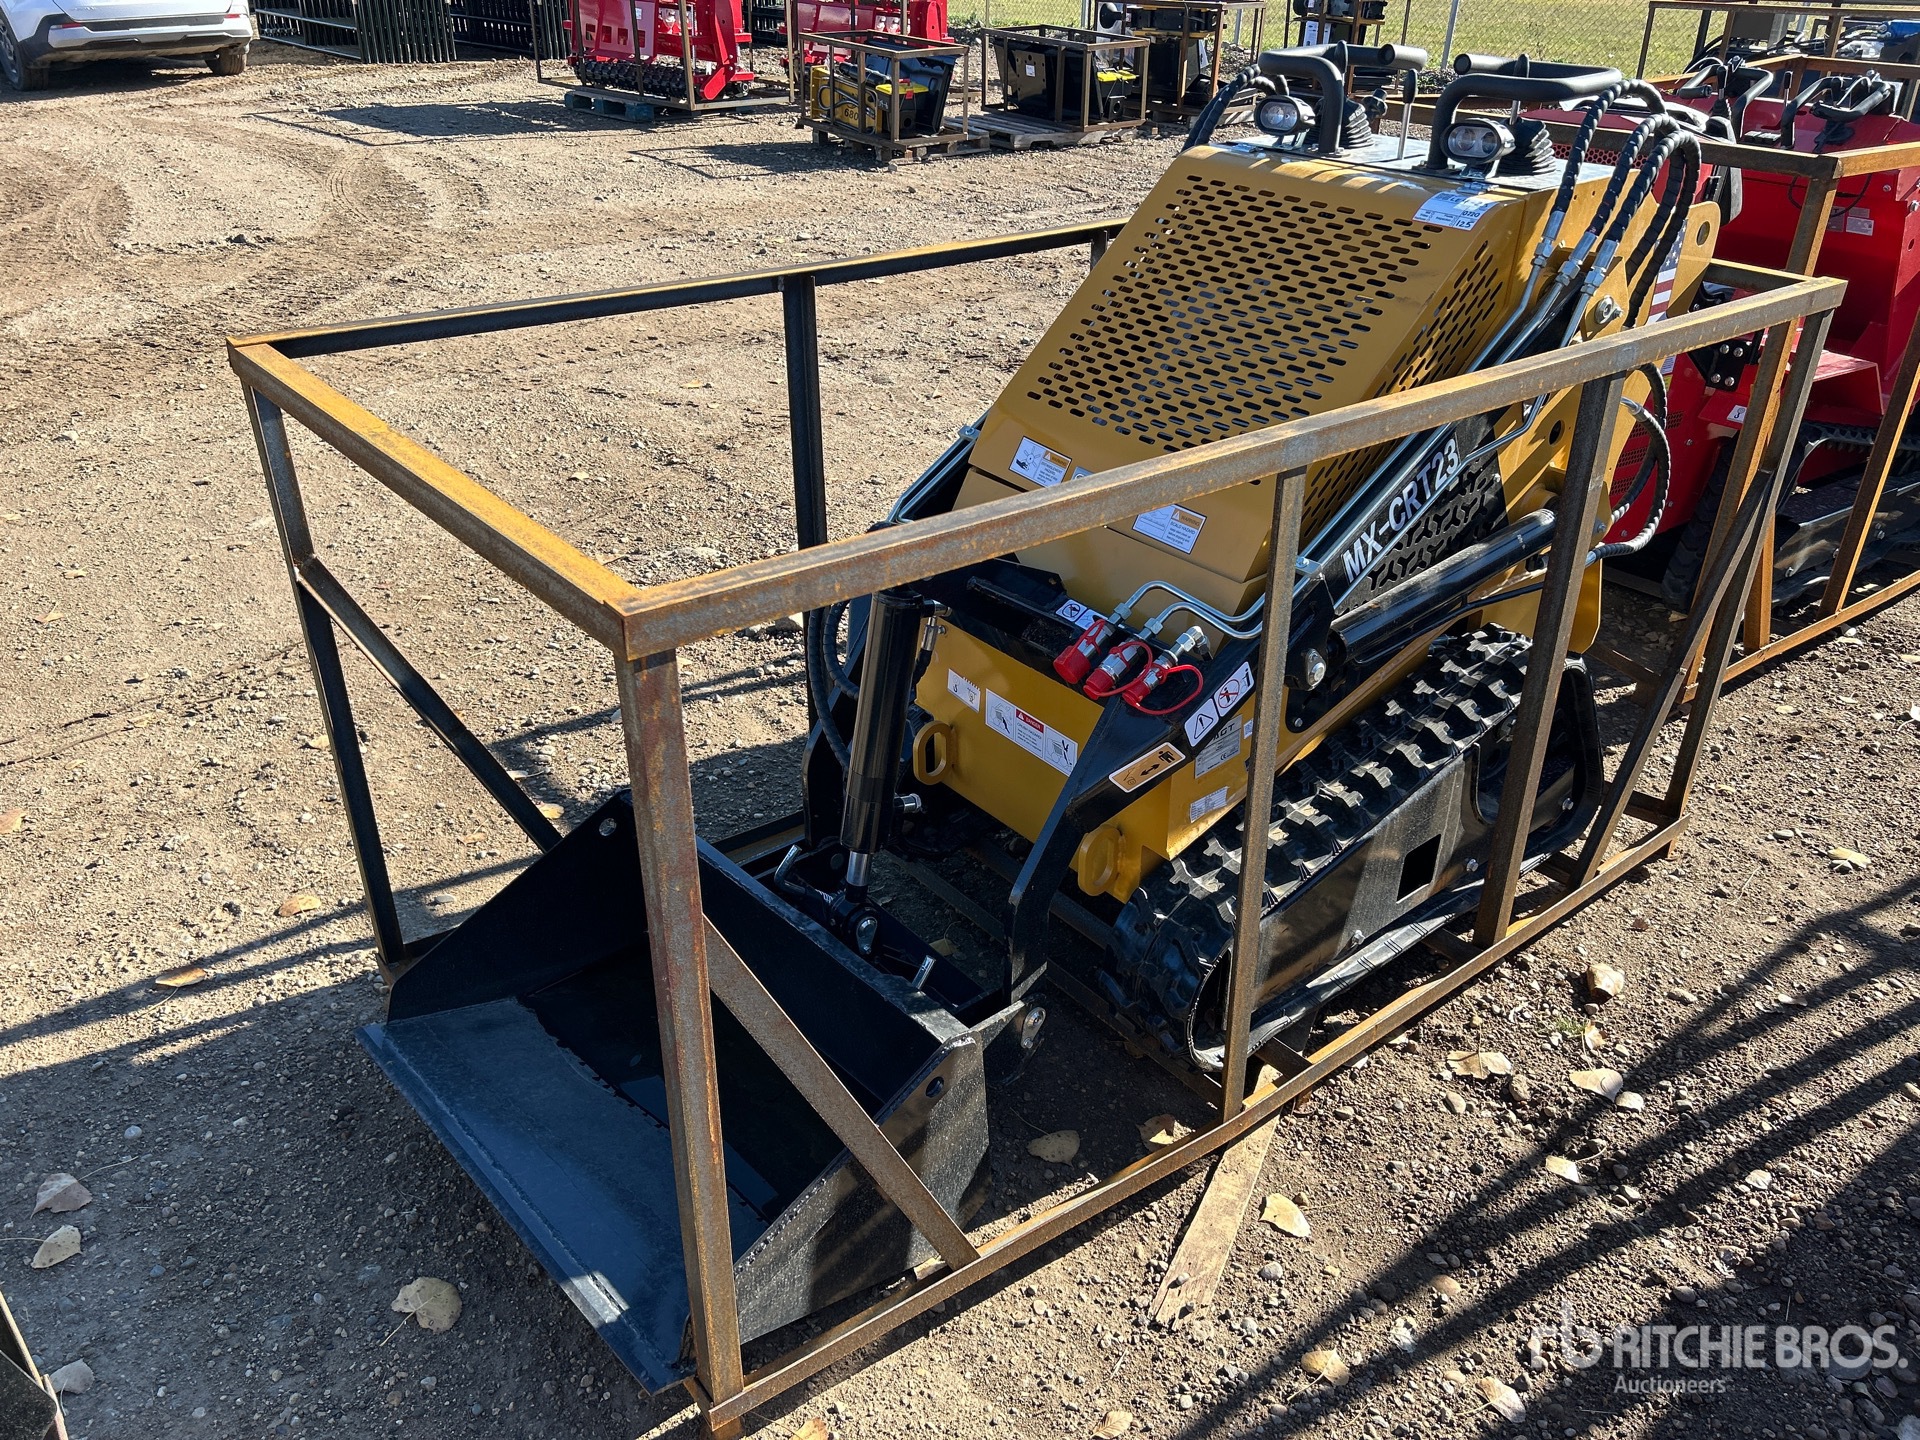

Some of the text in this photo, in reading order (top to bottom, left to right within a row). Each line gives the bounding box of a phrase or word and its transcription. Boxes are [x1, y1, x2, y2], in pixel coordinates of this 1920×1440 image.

[1343, 438, 1460, 583] MX-CRT23
[1181, 515, 1200, 526] WARNING
[1025, 717, 1041, 730] DANGER
